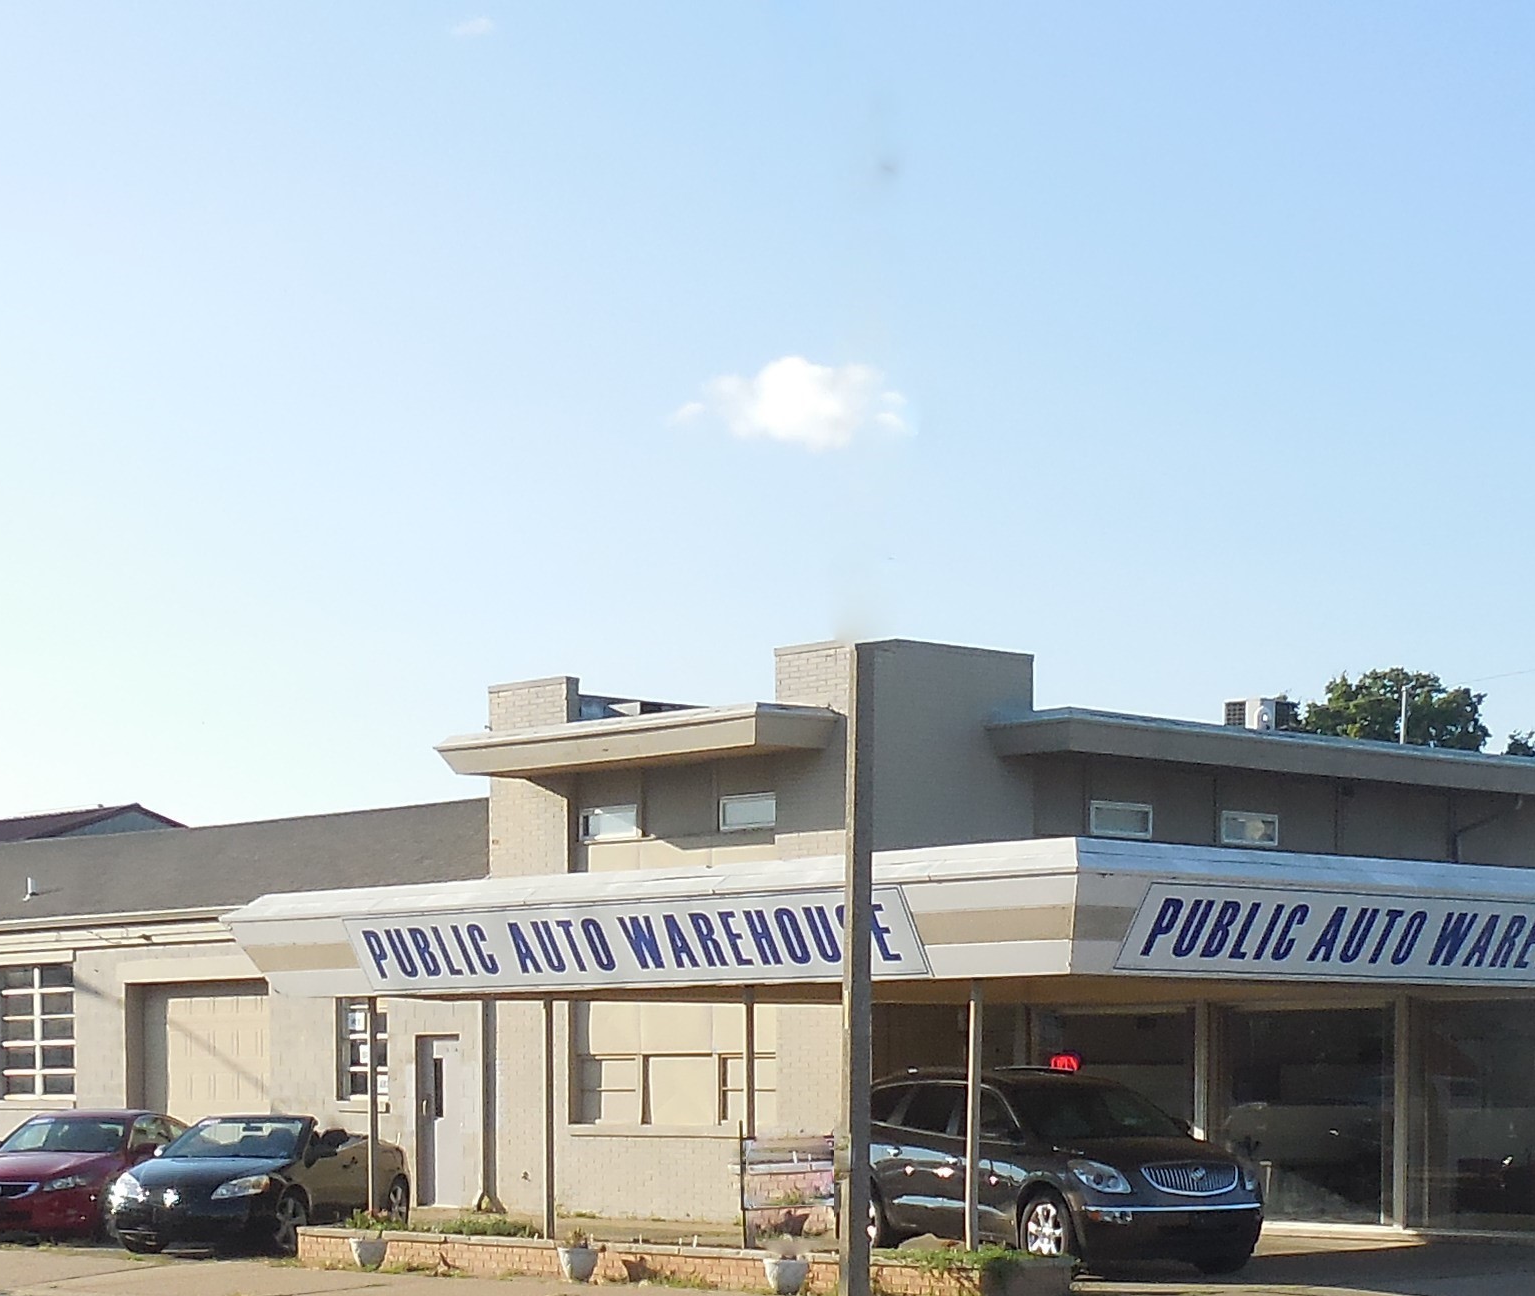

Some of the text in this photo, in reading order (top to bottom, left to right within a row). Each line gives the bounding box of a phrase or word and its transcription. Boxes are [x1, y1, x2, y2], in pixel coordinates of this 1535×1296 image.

[361, 923, 500, 980] PUBLIC
[508, 916, 618, 974] AUTO
[1140, 897, 1311, 963] PUBLIC
[1305, 906, 1429, 966] AUTO
